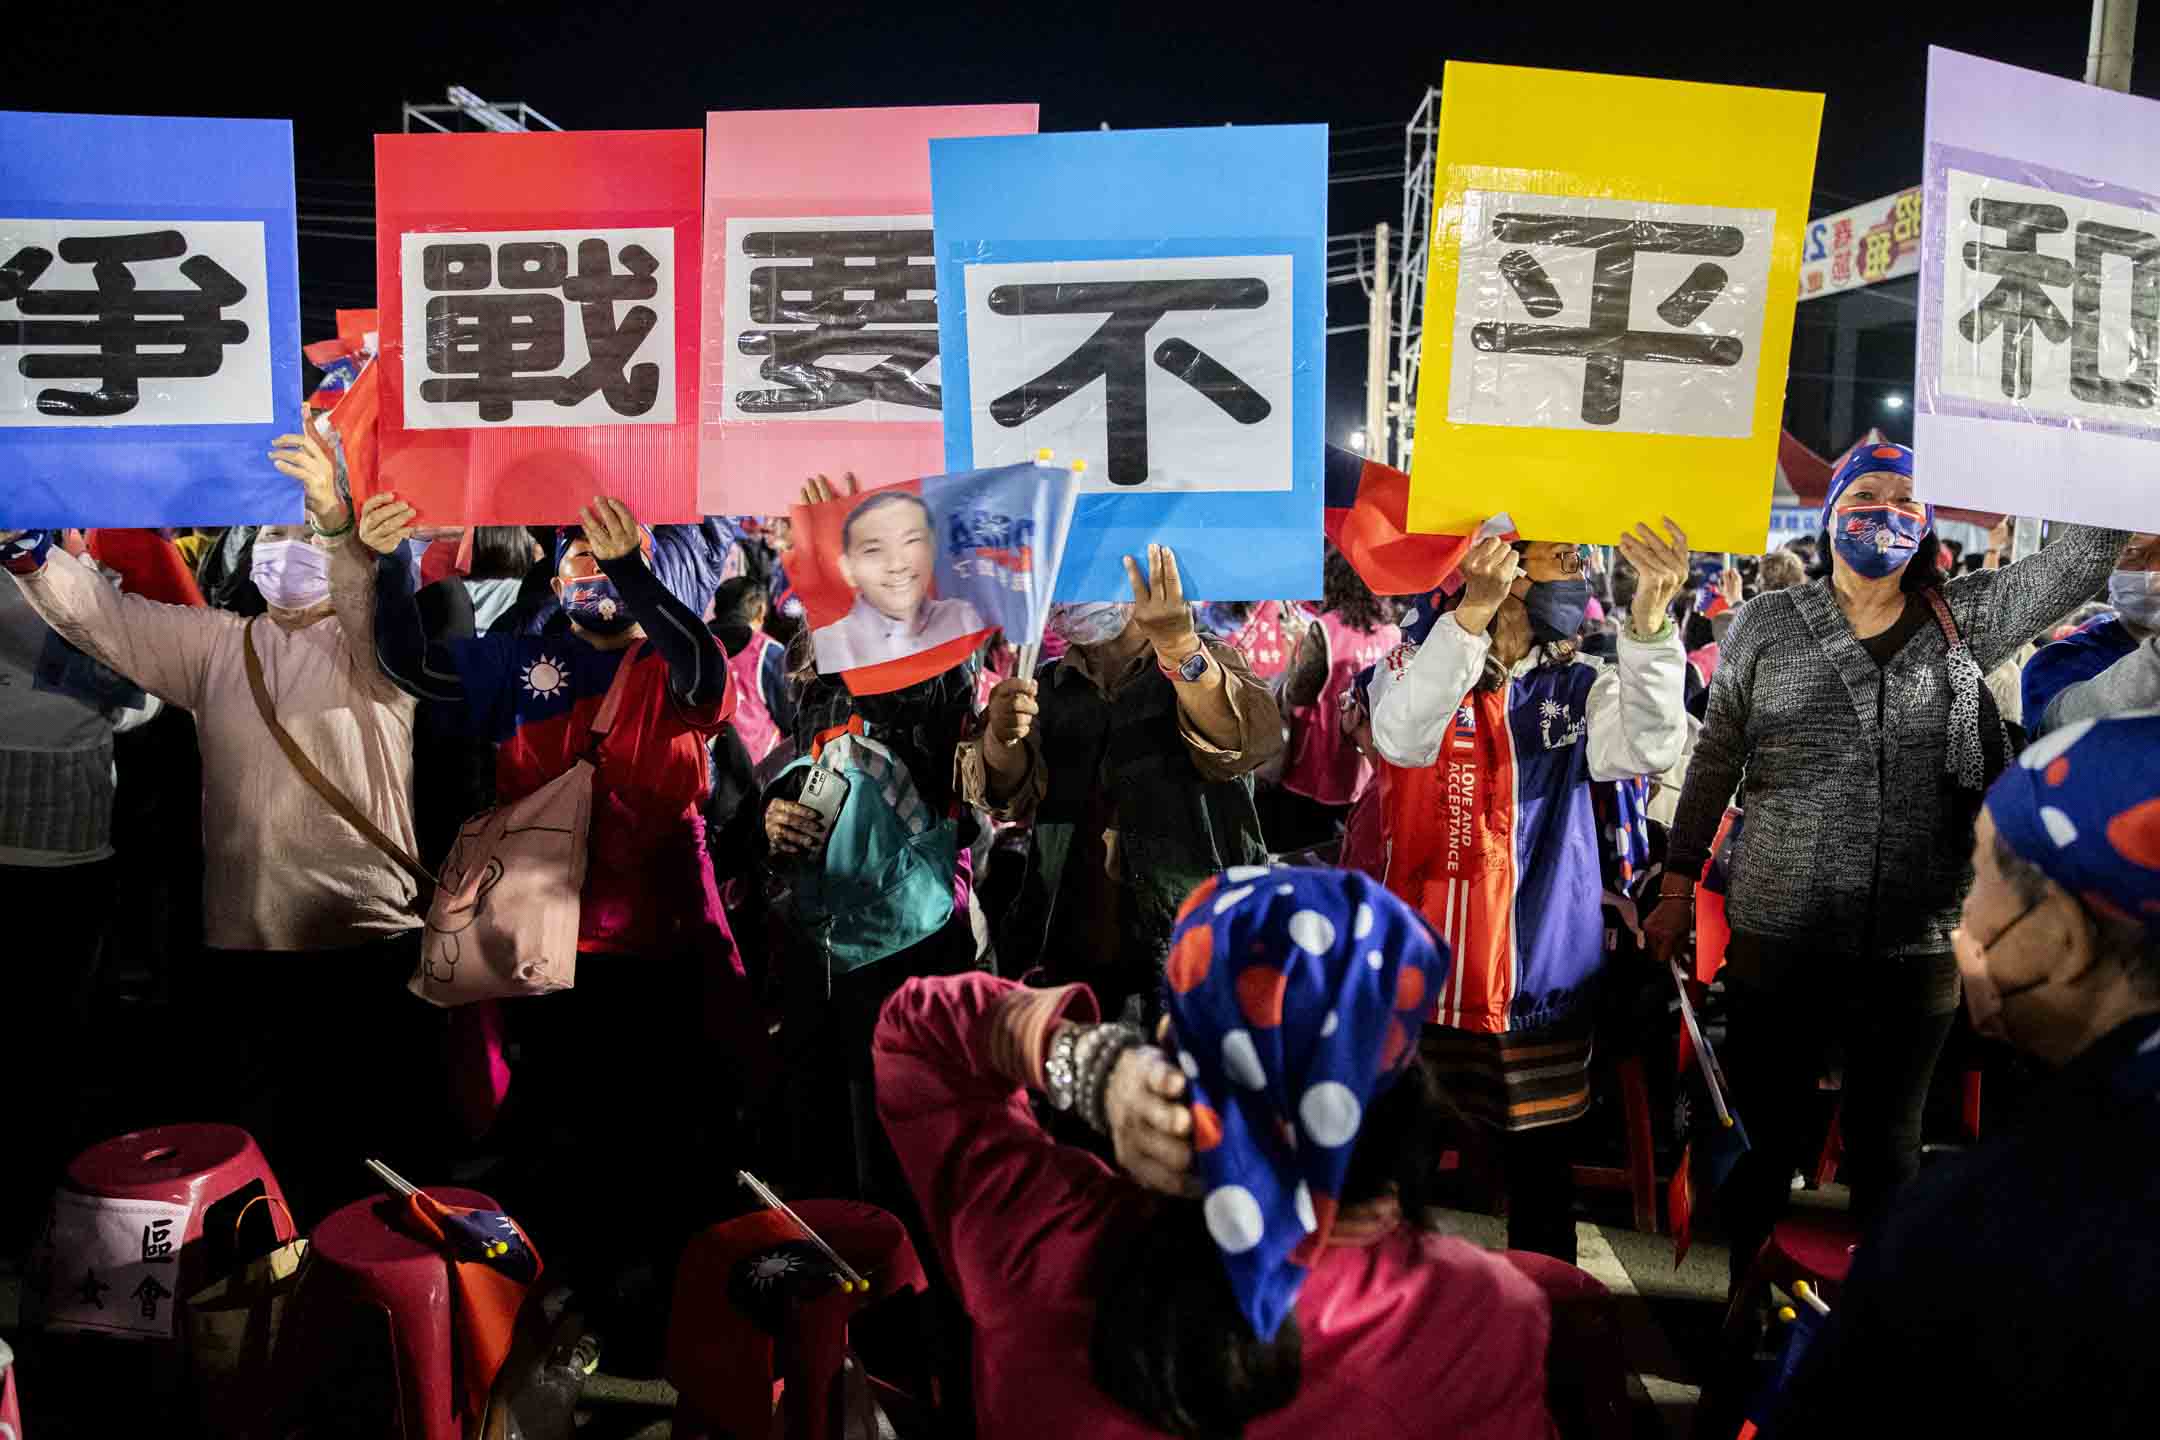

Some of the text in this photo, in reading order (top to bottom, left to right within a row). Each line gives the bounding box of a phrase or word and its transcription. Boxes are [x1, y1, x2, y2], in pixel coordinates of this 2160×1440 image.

[0, 229, 249, 416] 爭
[420, 238, 659, 422] 戰
[736, 229, 943, 413] 要
[988, 277, 1271, 486] 不
[1470, 212, 1745, 426] 平
[1958, 197, 2160, 409] 和
[1447, 760, 1461, 872] ACCEPTANCE
[1461, 763, 1477, 848] LOVE AND
